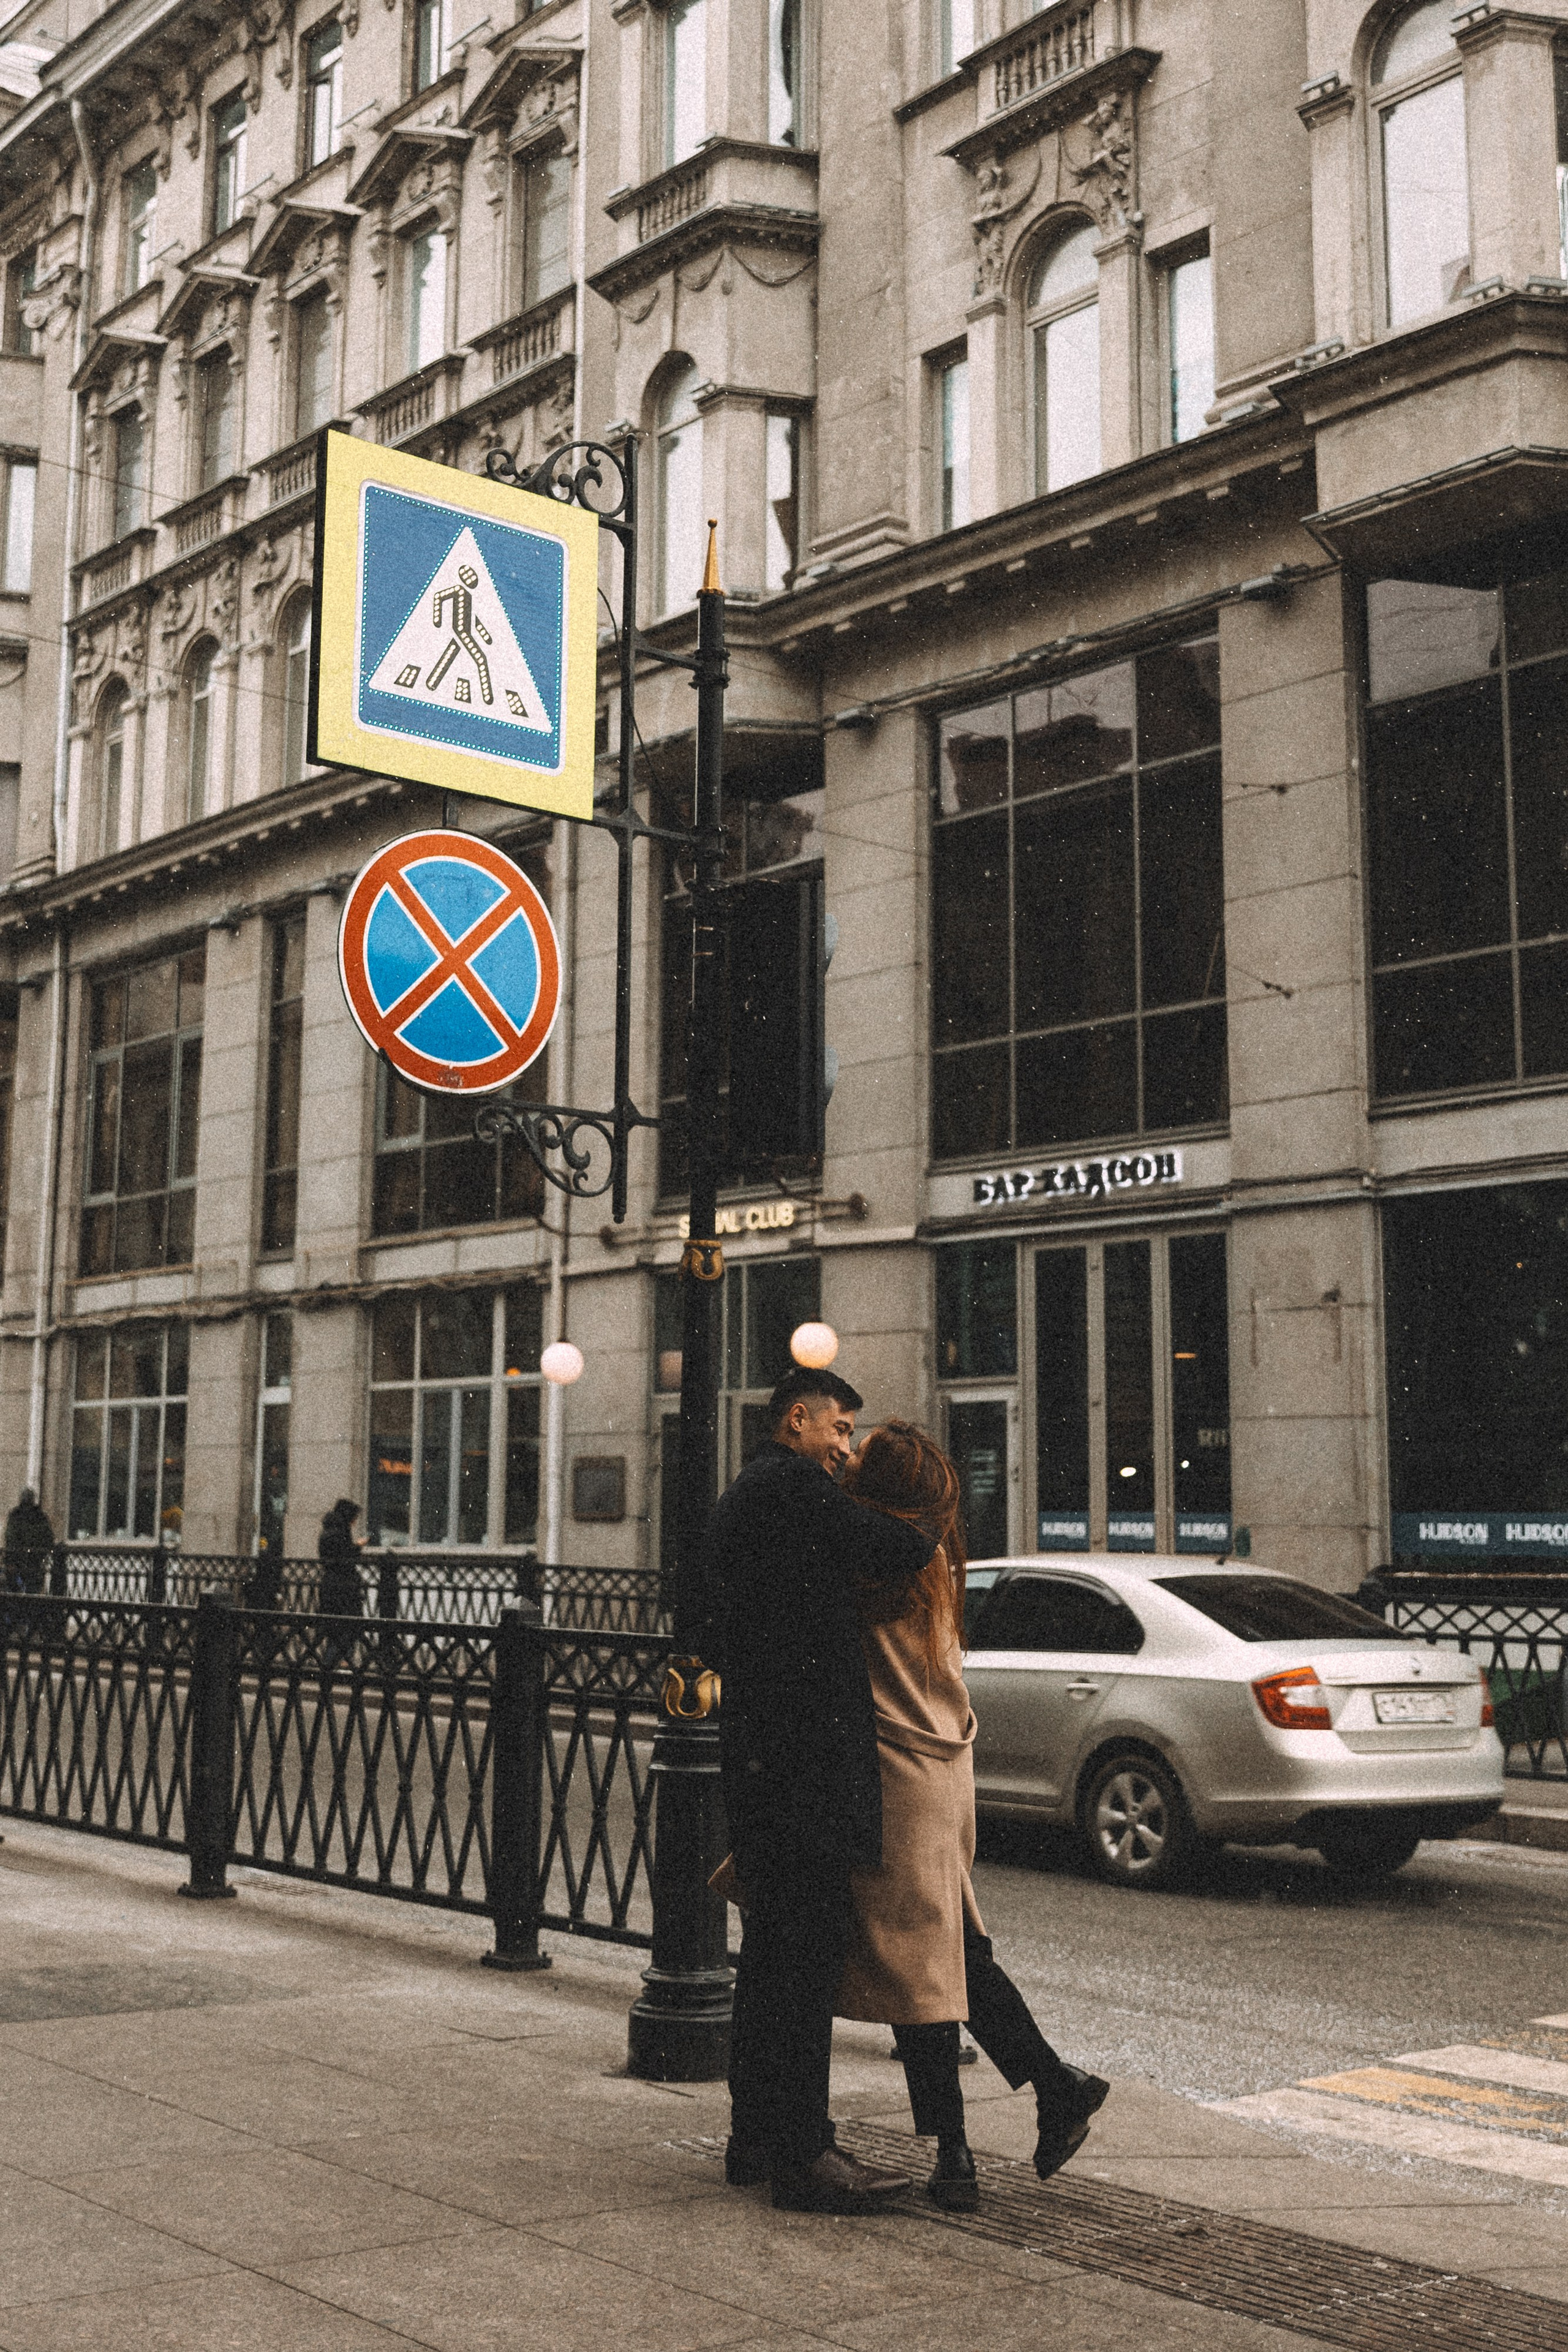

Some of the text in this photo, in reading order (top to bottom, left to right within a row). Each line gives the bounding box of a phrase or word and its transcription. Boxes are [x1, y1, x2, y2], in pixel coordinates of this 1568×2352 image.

[974, 1150, 1183, 1206] БАР ХАДСОН
[745, 1202, 795, 1231] CLUB
[1419, 1522, 1488, 1541] HUDSON
